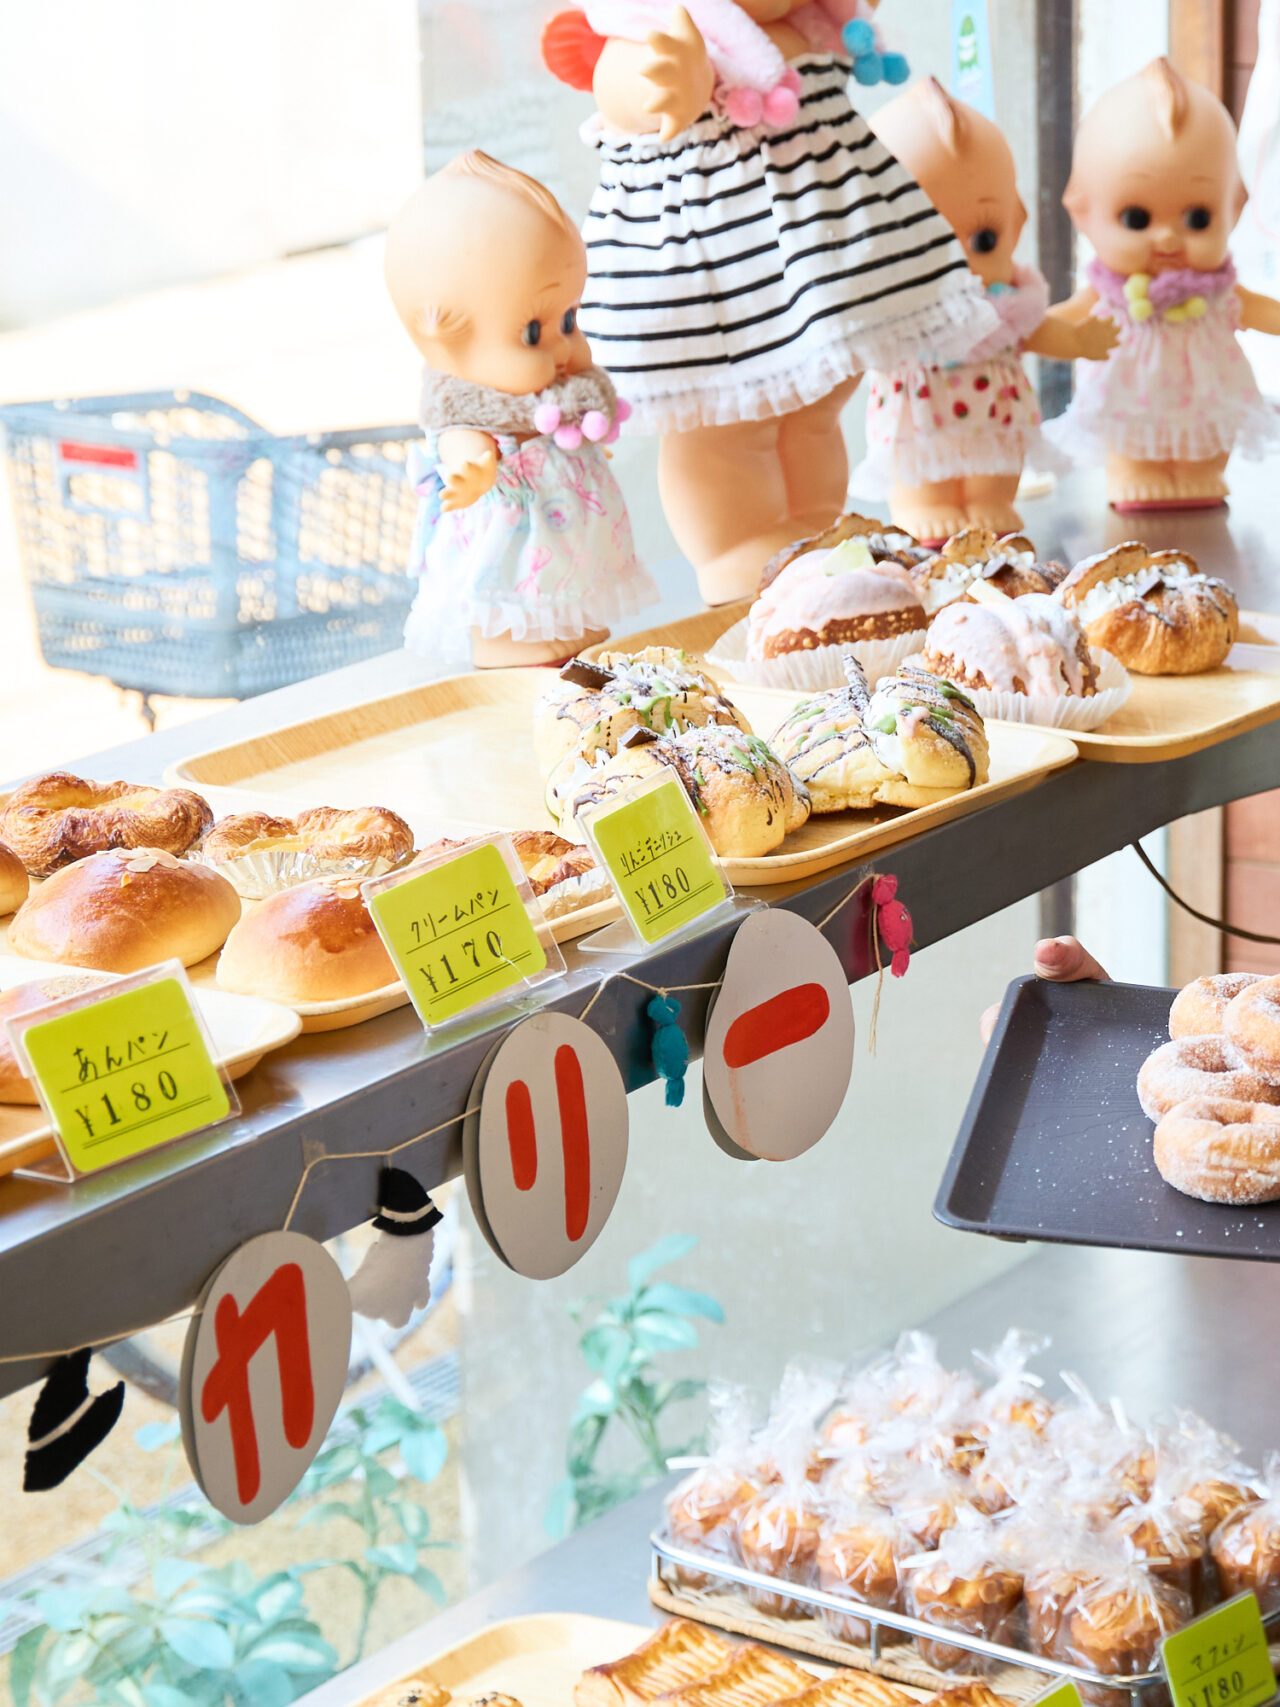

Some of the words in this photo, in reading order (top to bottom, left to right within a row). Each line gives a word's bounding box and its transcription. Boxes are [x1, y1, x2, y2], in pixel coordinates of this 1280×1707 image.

[410, 889, 499, 943] クリームパン
[635, 867, 690, 915] ¥180
[419, 930, 503, 993] ¥170
[73, 1030, 168, 1083] あんパン
[75, 1070, 178, 1137] ¥180
